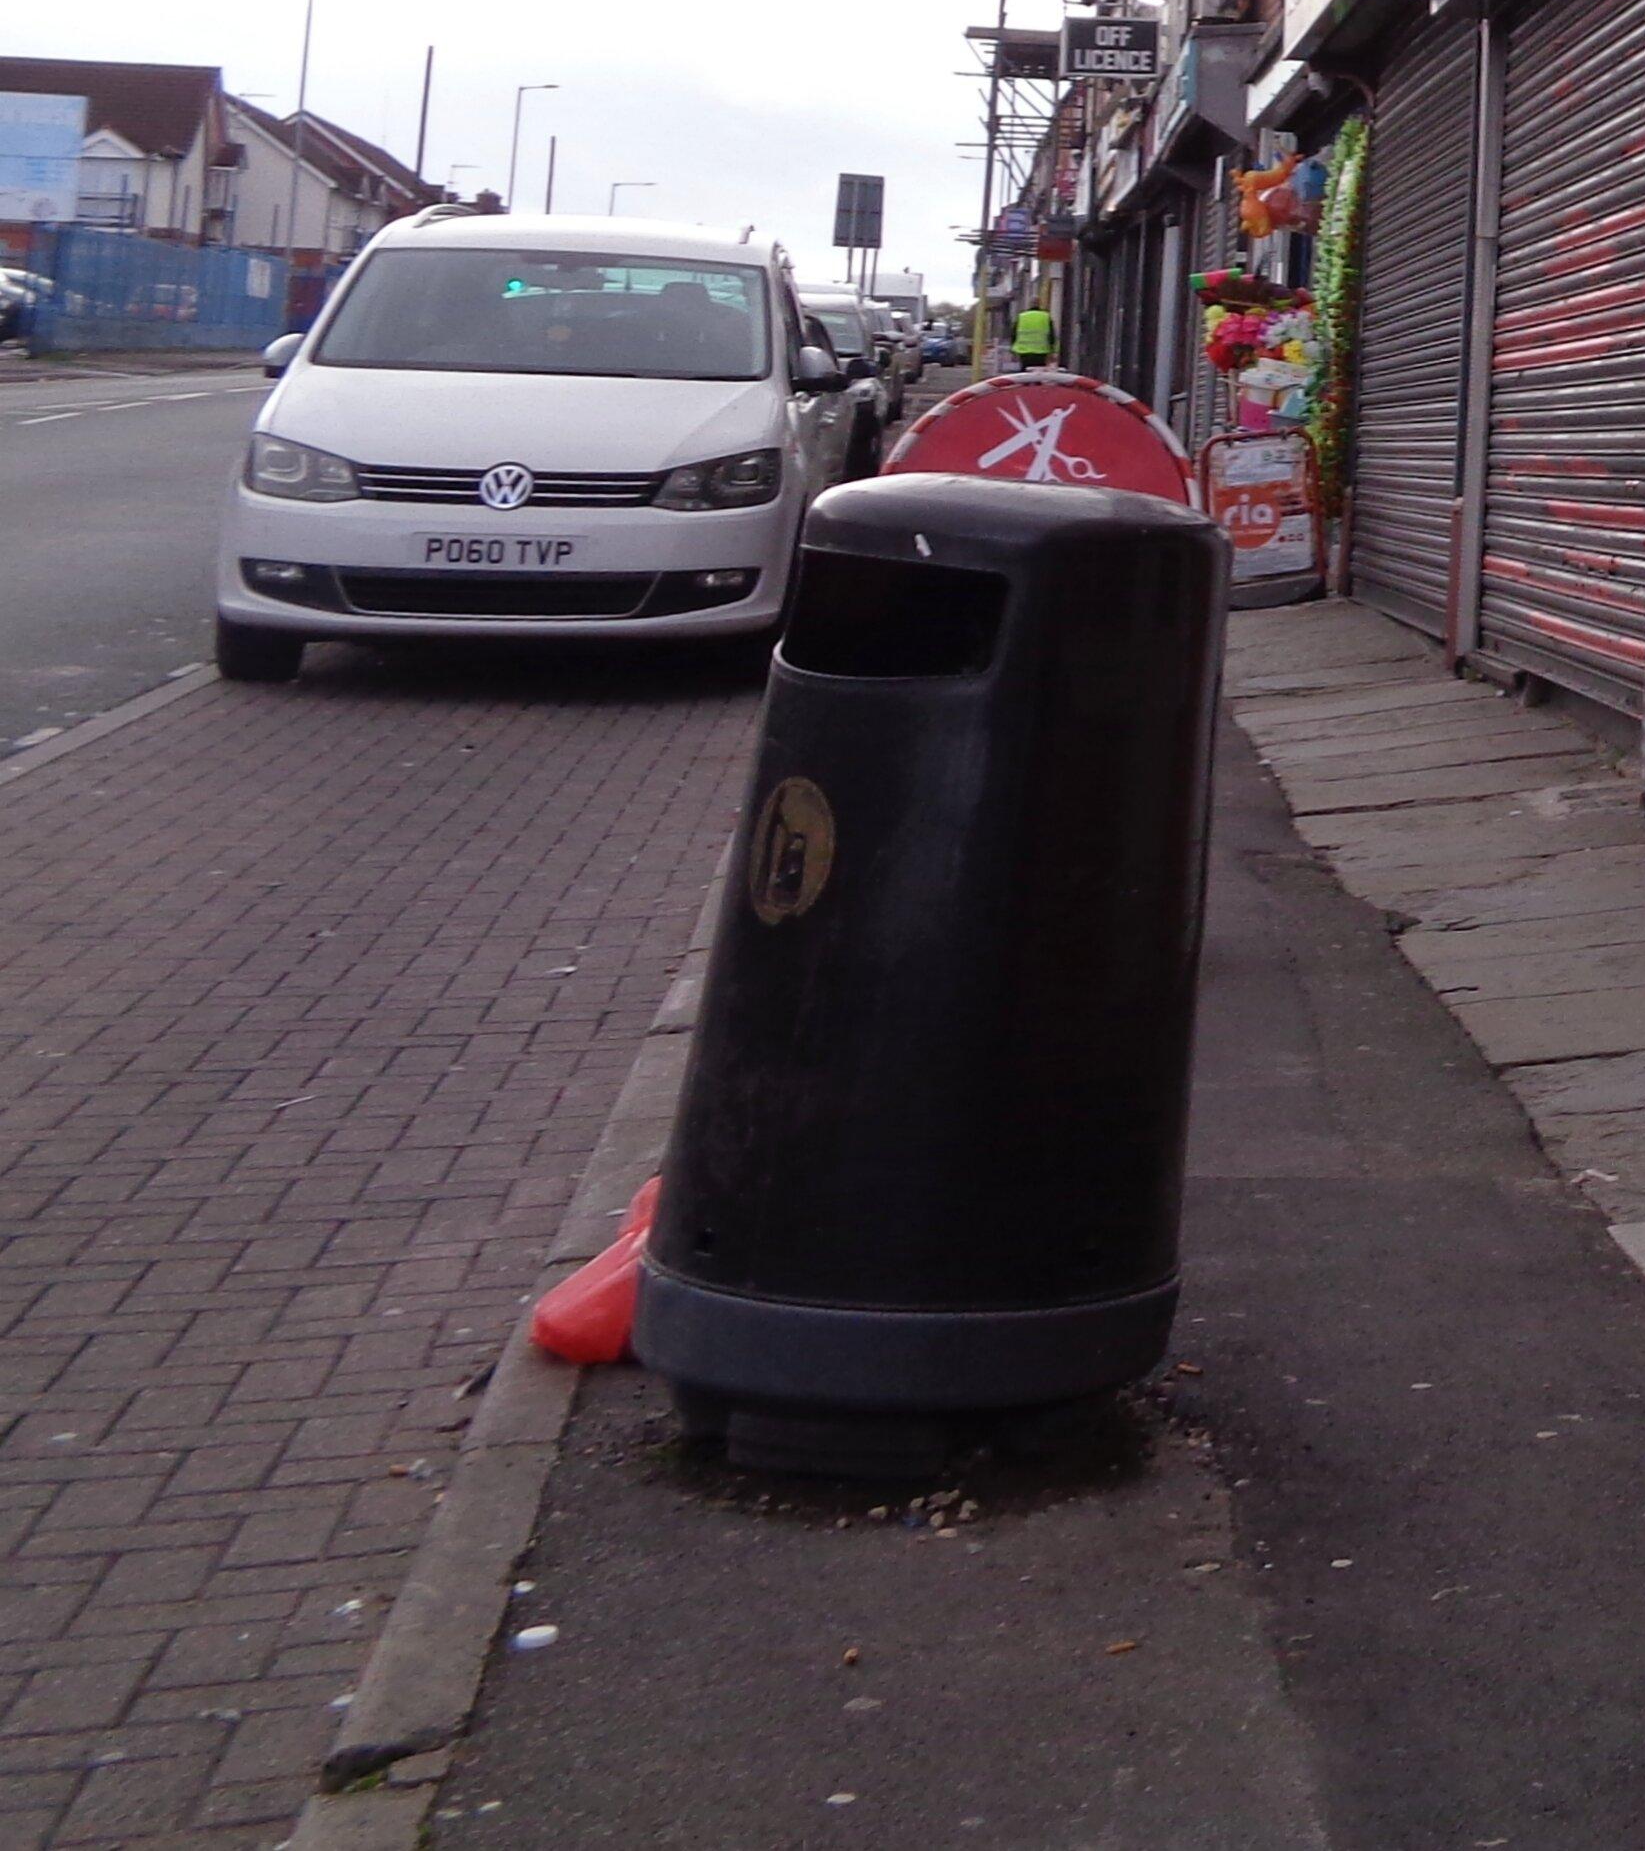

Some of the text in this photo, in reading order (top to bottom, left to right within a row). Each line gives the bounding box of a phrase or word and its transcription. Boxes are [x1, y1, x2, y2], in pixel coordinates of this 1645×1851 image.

[1074, 26, 1153, 71] OFF LICENCE
[1223, 493, 1274, 526] ria
[425, 538, 573, 565] PO60 TVP
